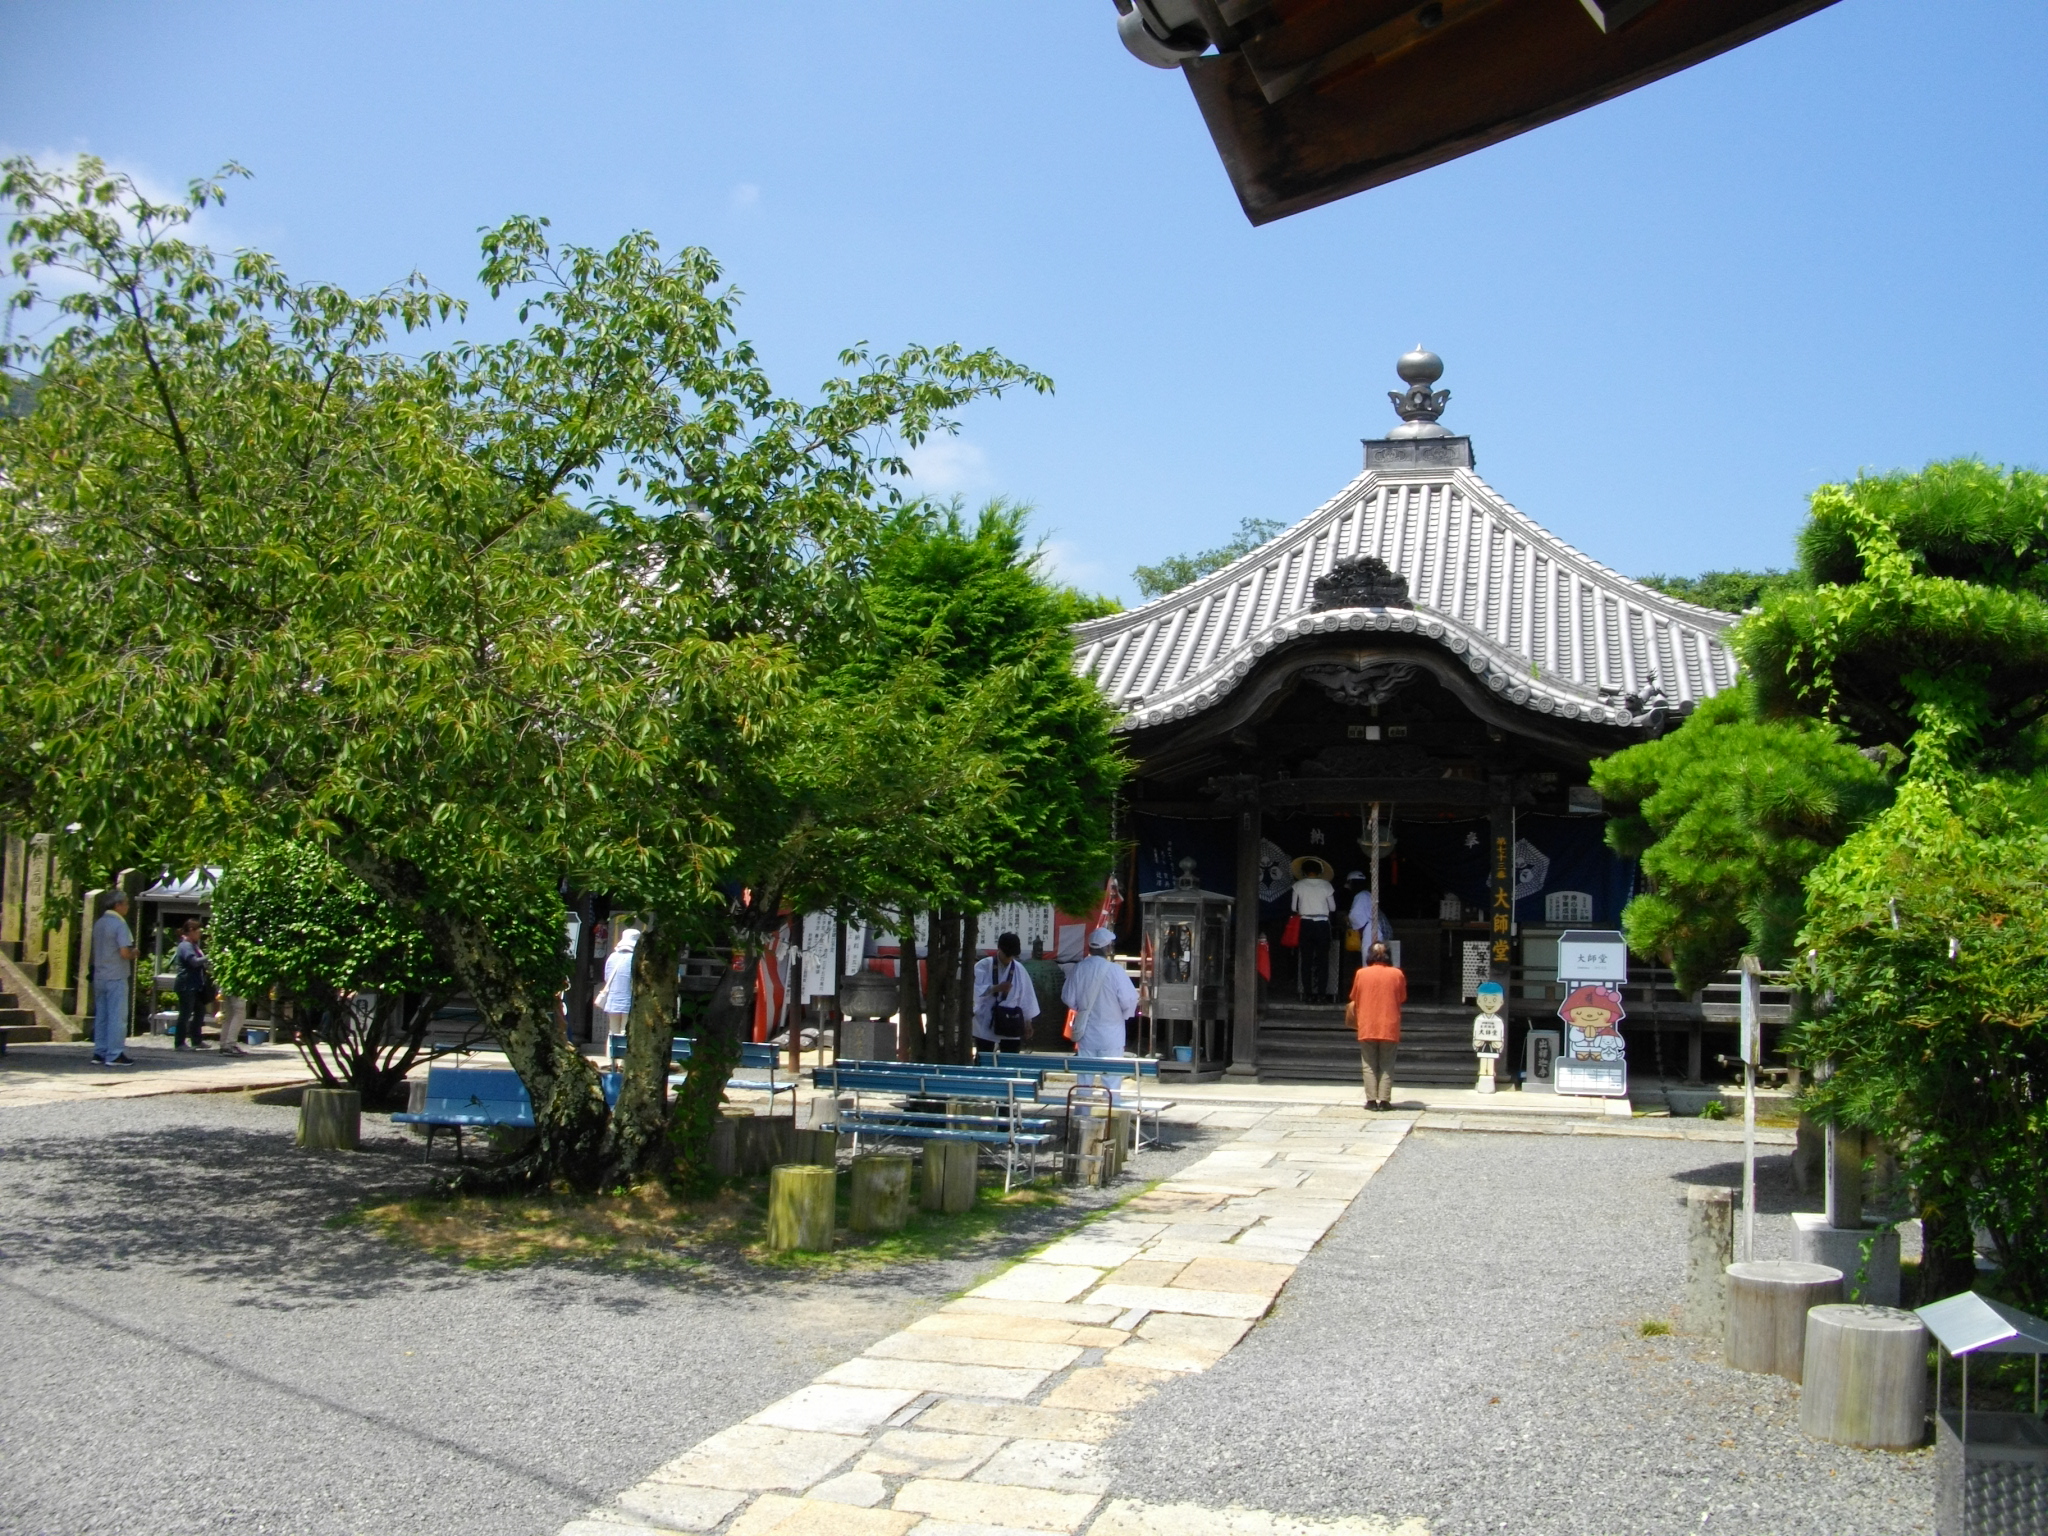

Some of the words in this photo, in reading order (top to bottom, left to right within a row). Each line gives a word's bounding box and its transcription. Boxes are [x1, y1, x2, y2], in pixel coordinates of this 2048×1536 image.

[1310, 828, 1325, 845] 納
[1464, 831, 1480, 849] 奉
[1492, 886, 1511, 962] 大師堂
[1577, 953, 1608, 964] 大師堂
